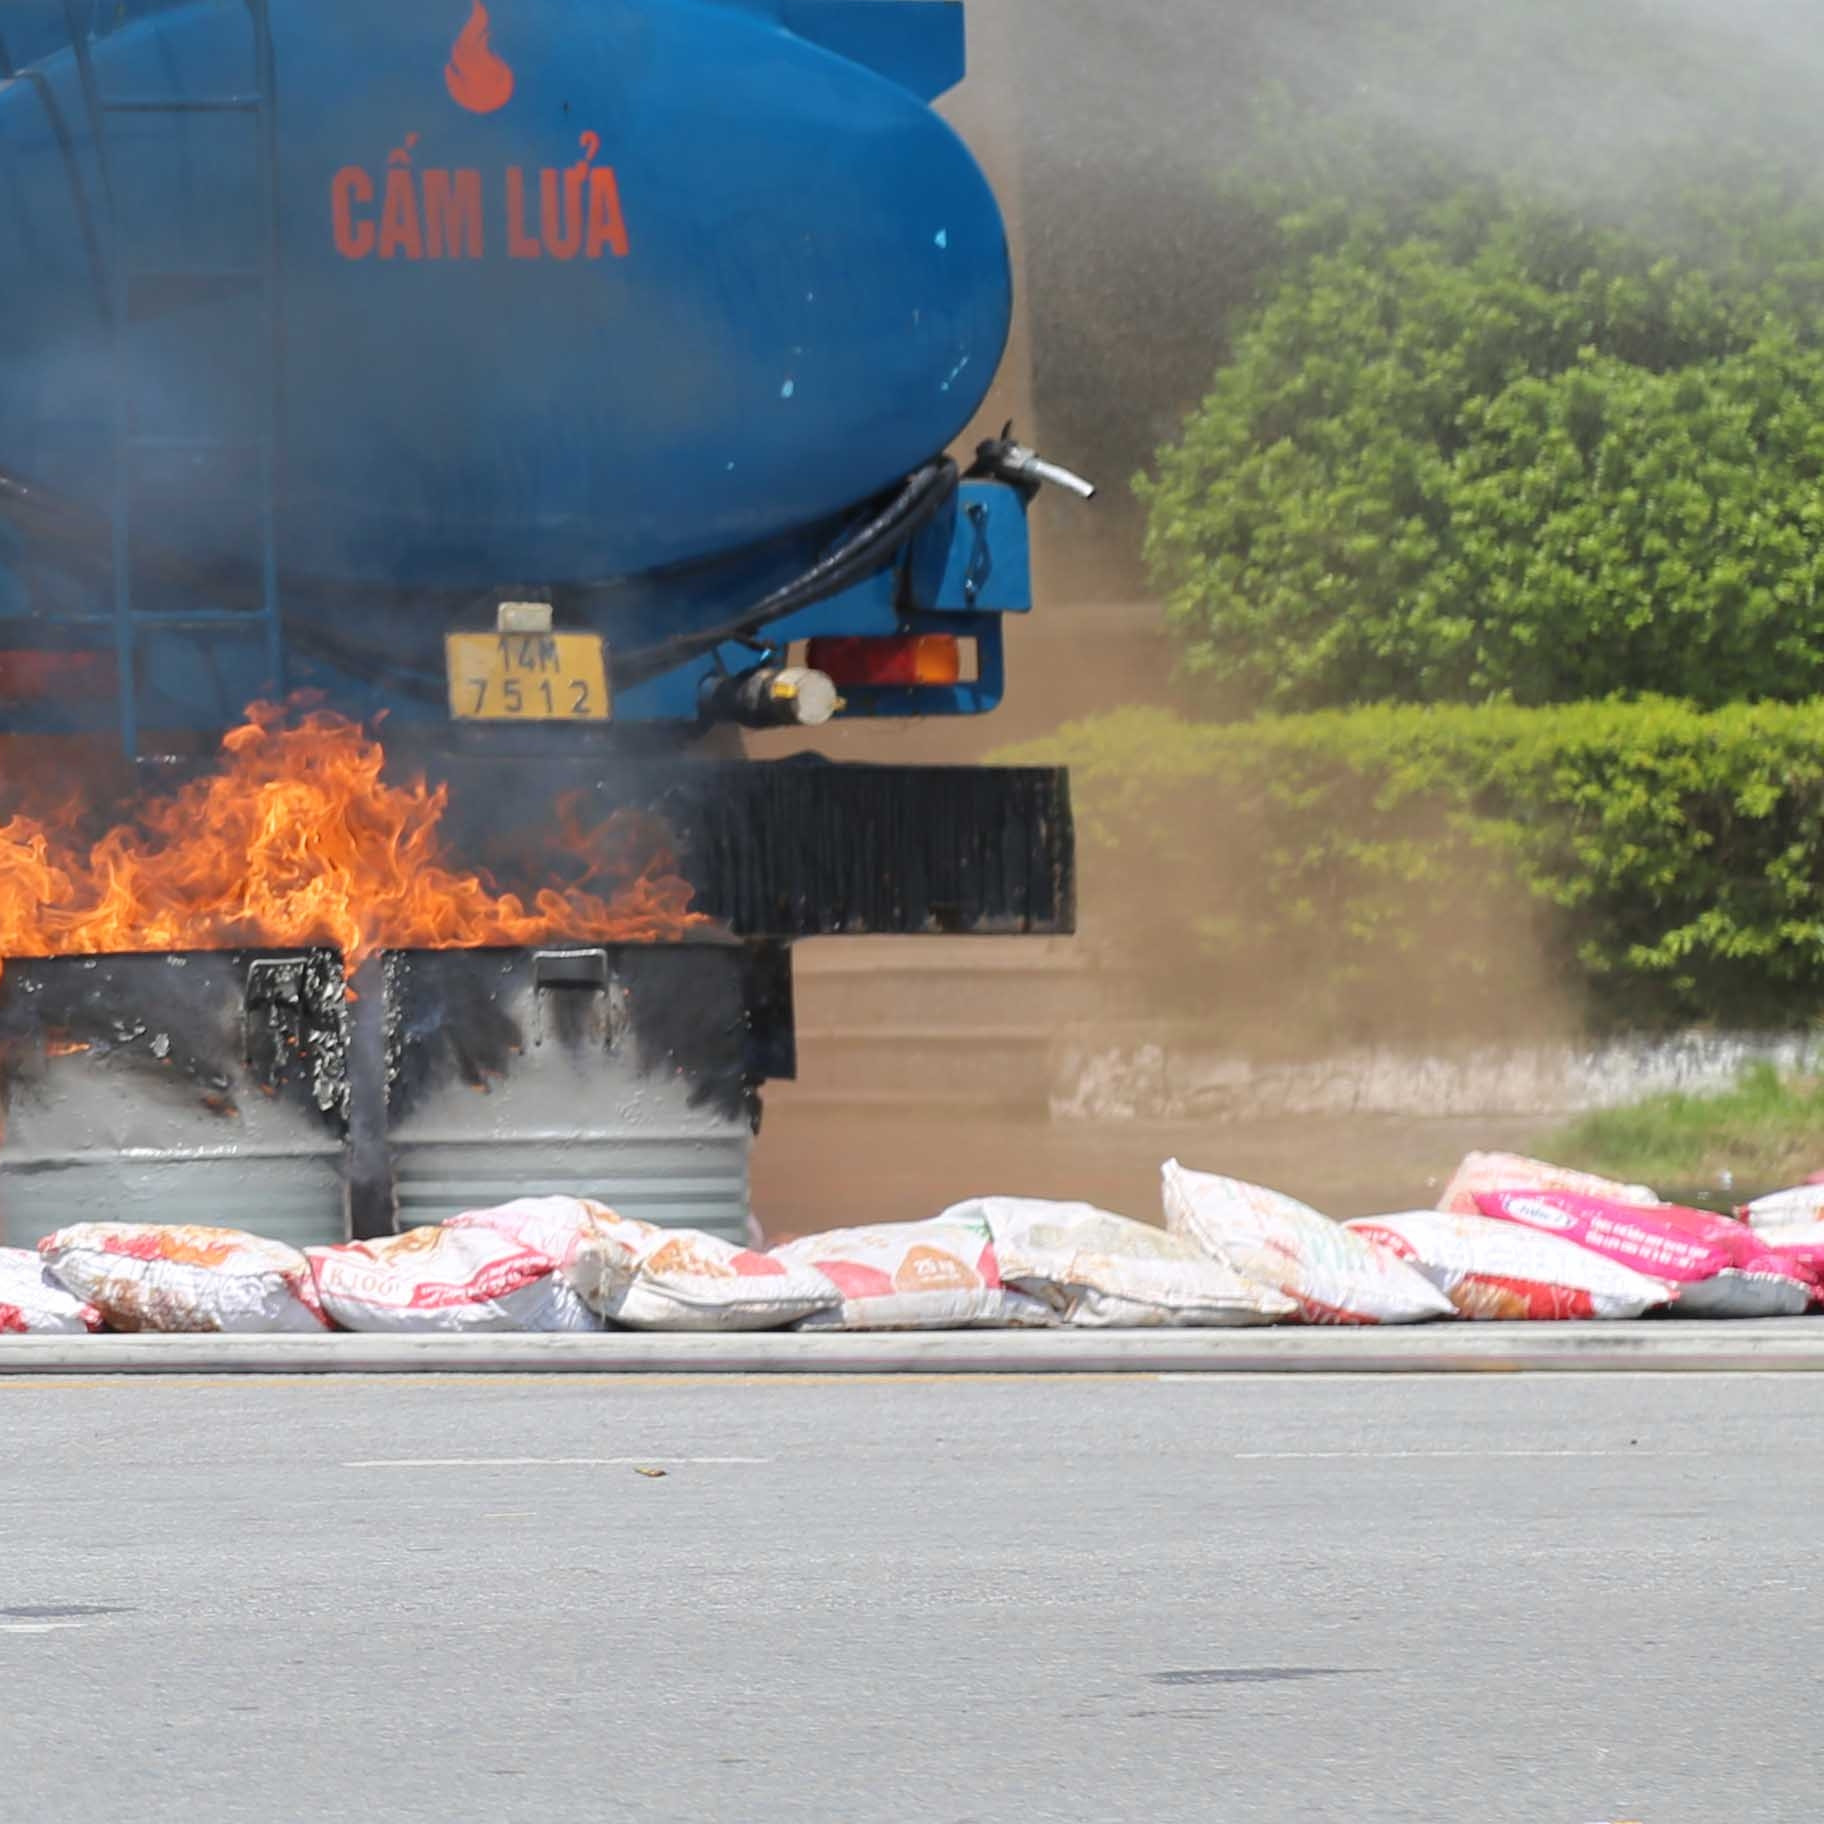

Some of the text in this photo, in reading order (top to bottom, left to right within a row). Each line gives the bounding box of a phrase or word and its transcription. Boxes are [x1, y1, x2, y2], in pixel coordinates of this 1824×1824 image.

[331, 129, 630, 260] CẤM LỬA
[498, 636, 561, 673] 14M
[468, 677, 592, 715] 7512
